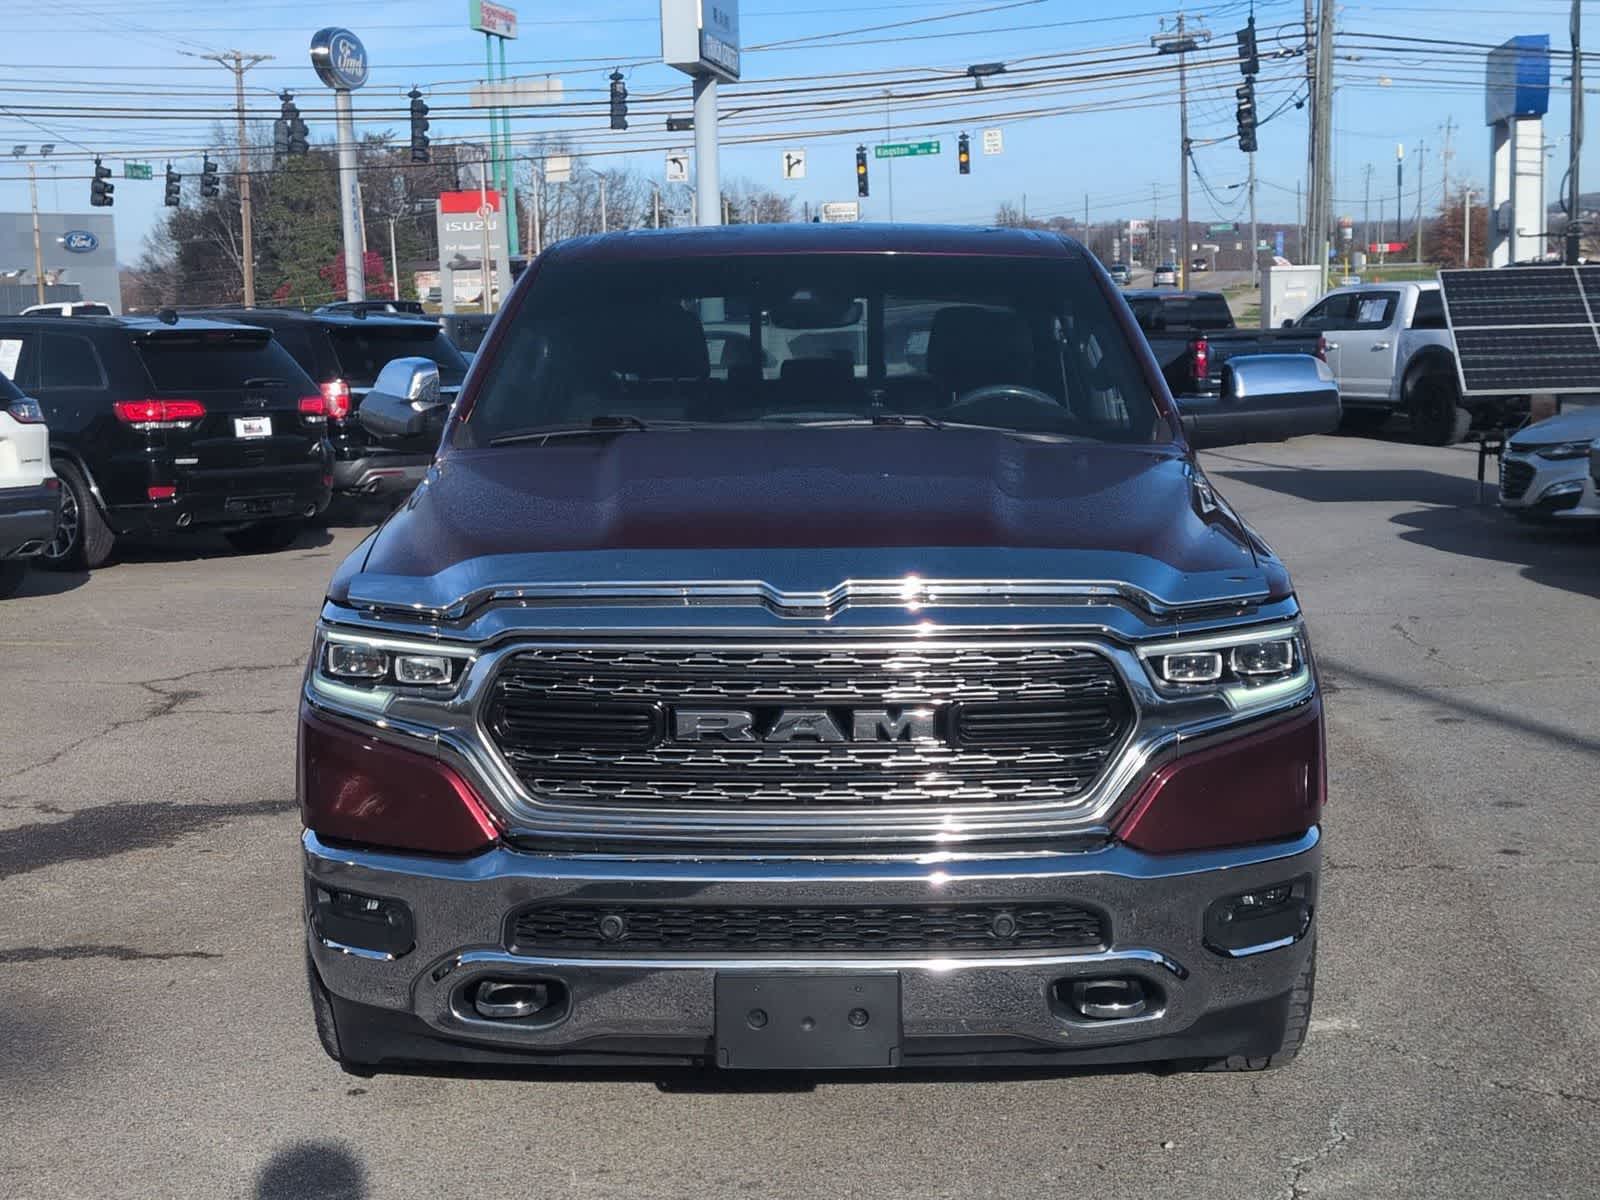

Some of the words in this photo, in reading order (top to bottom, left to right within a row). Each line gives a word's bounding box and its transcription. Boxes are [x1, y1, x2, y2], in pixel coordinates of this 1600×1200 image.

[337, 39, 364, 77] Ford
[446, 221, 497, 232] ISUZU
[71, 234, 92, 248] Ford
[676, 710, 936, 742] RAM
